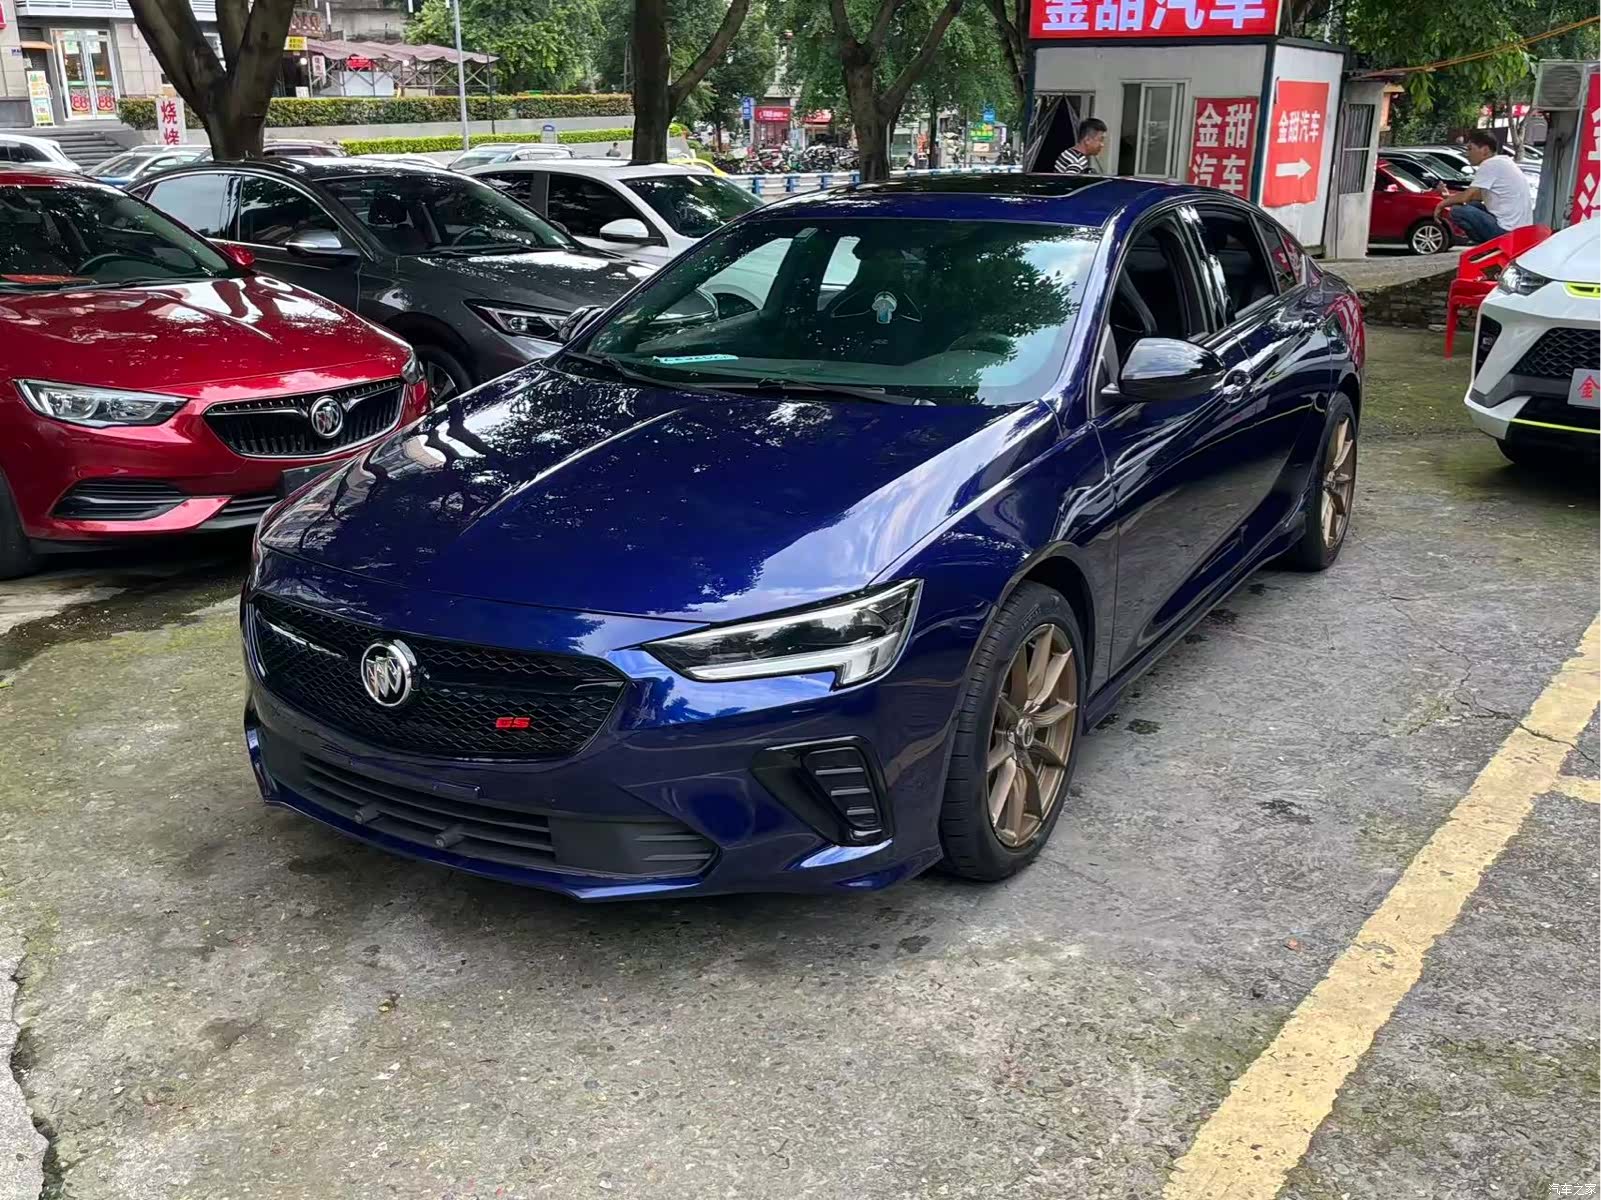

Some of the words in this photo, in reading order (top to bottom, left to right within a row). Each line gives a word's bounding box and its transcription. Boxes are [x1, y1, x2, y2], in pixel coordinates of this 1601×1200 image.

[1196, 102, 1253, 149] 金甜
[1276, 109, 1321, 144] 金甜汽车
[1191, 152, 1247, 195] 汽车
[1577, 374, 1601, 399] 金
[496, 716, 531, 728] GS
